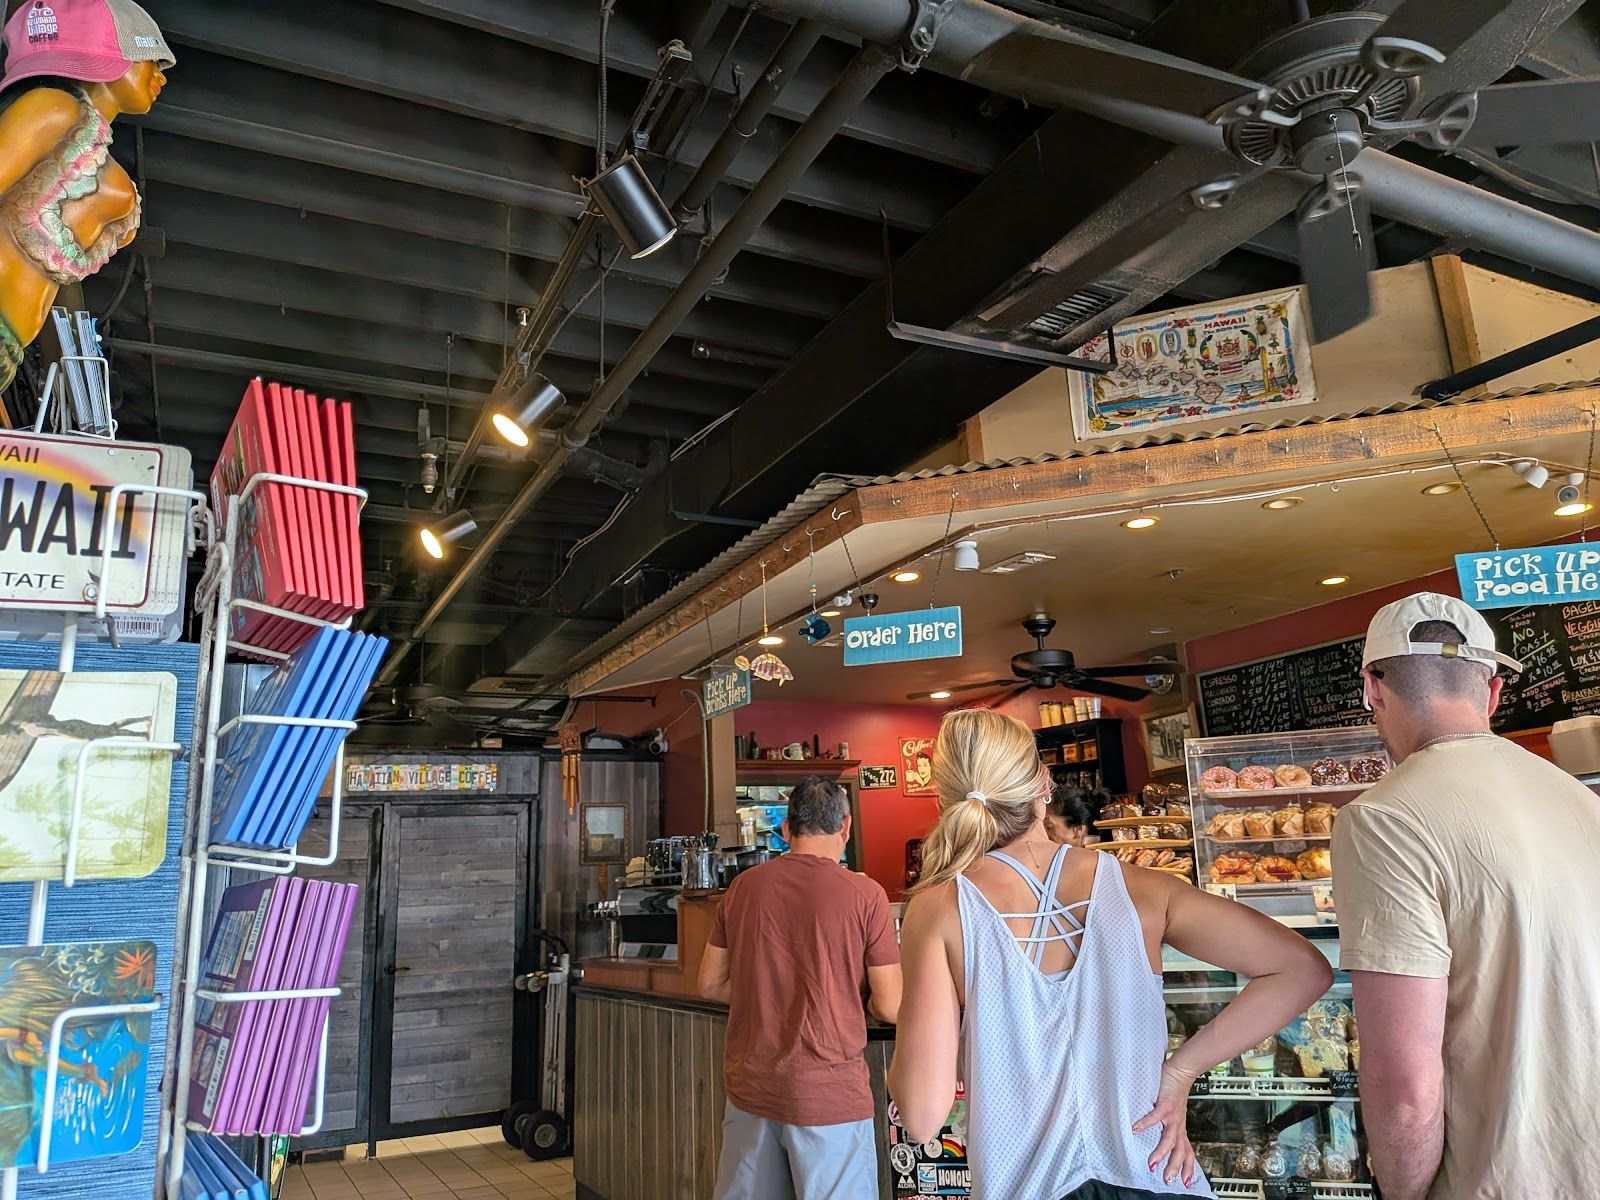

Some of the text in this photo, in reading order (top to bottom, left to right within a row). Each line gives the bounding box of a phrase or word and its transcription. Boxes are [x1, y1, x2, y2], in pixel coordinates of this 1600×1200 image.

[1204, 316, 1247, 329] HAWAII
[0, 446, 39, 463] AII
[1473, 554, 1543, 579] Pick
[1474, 573, 1548, 602] Food
[846, 621, 957, 649] Order Here
[706, 677, 724, 699] Pick
[1203, 674, 1238, 688] ESPRESSO
[728, 685, 747, 706] Here
[409, 767, 451, 786] VILLAGE
[459, 766, 497, 785] COFFEE
[880, 769, 895, 783] 272
